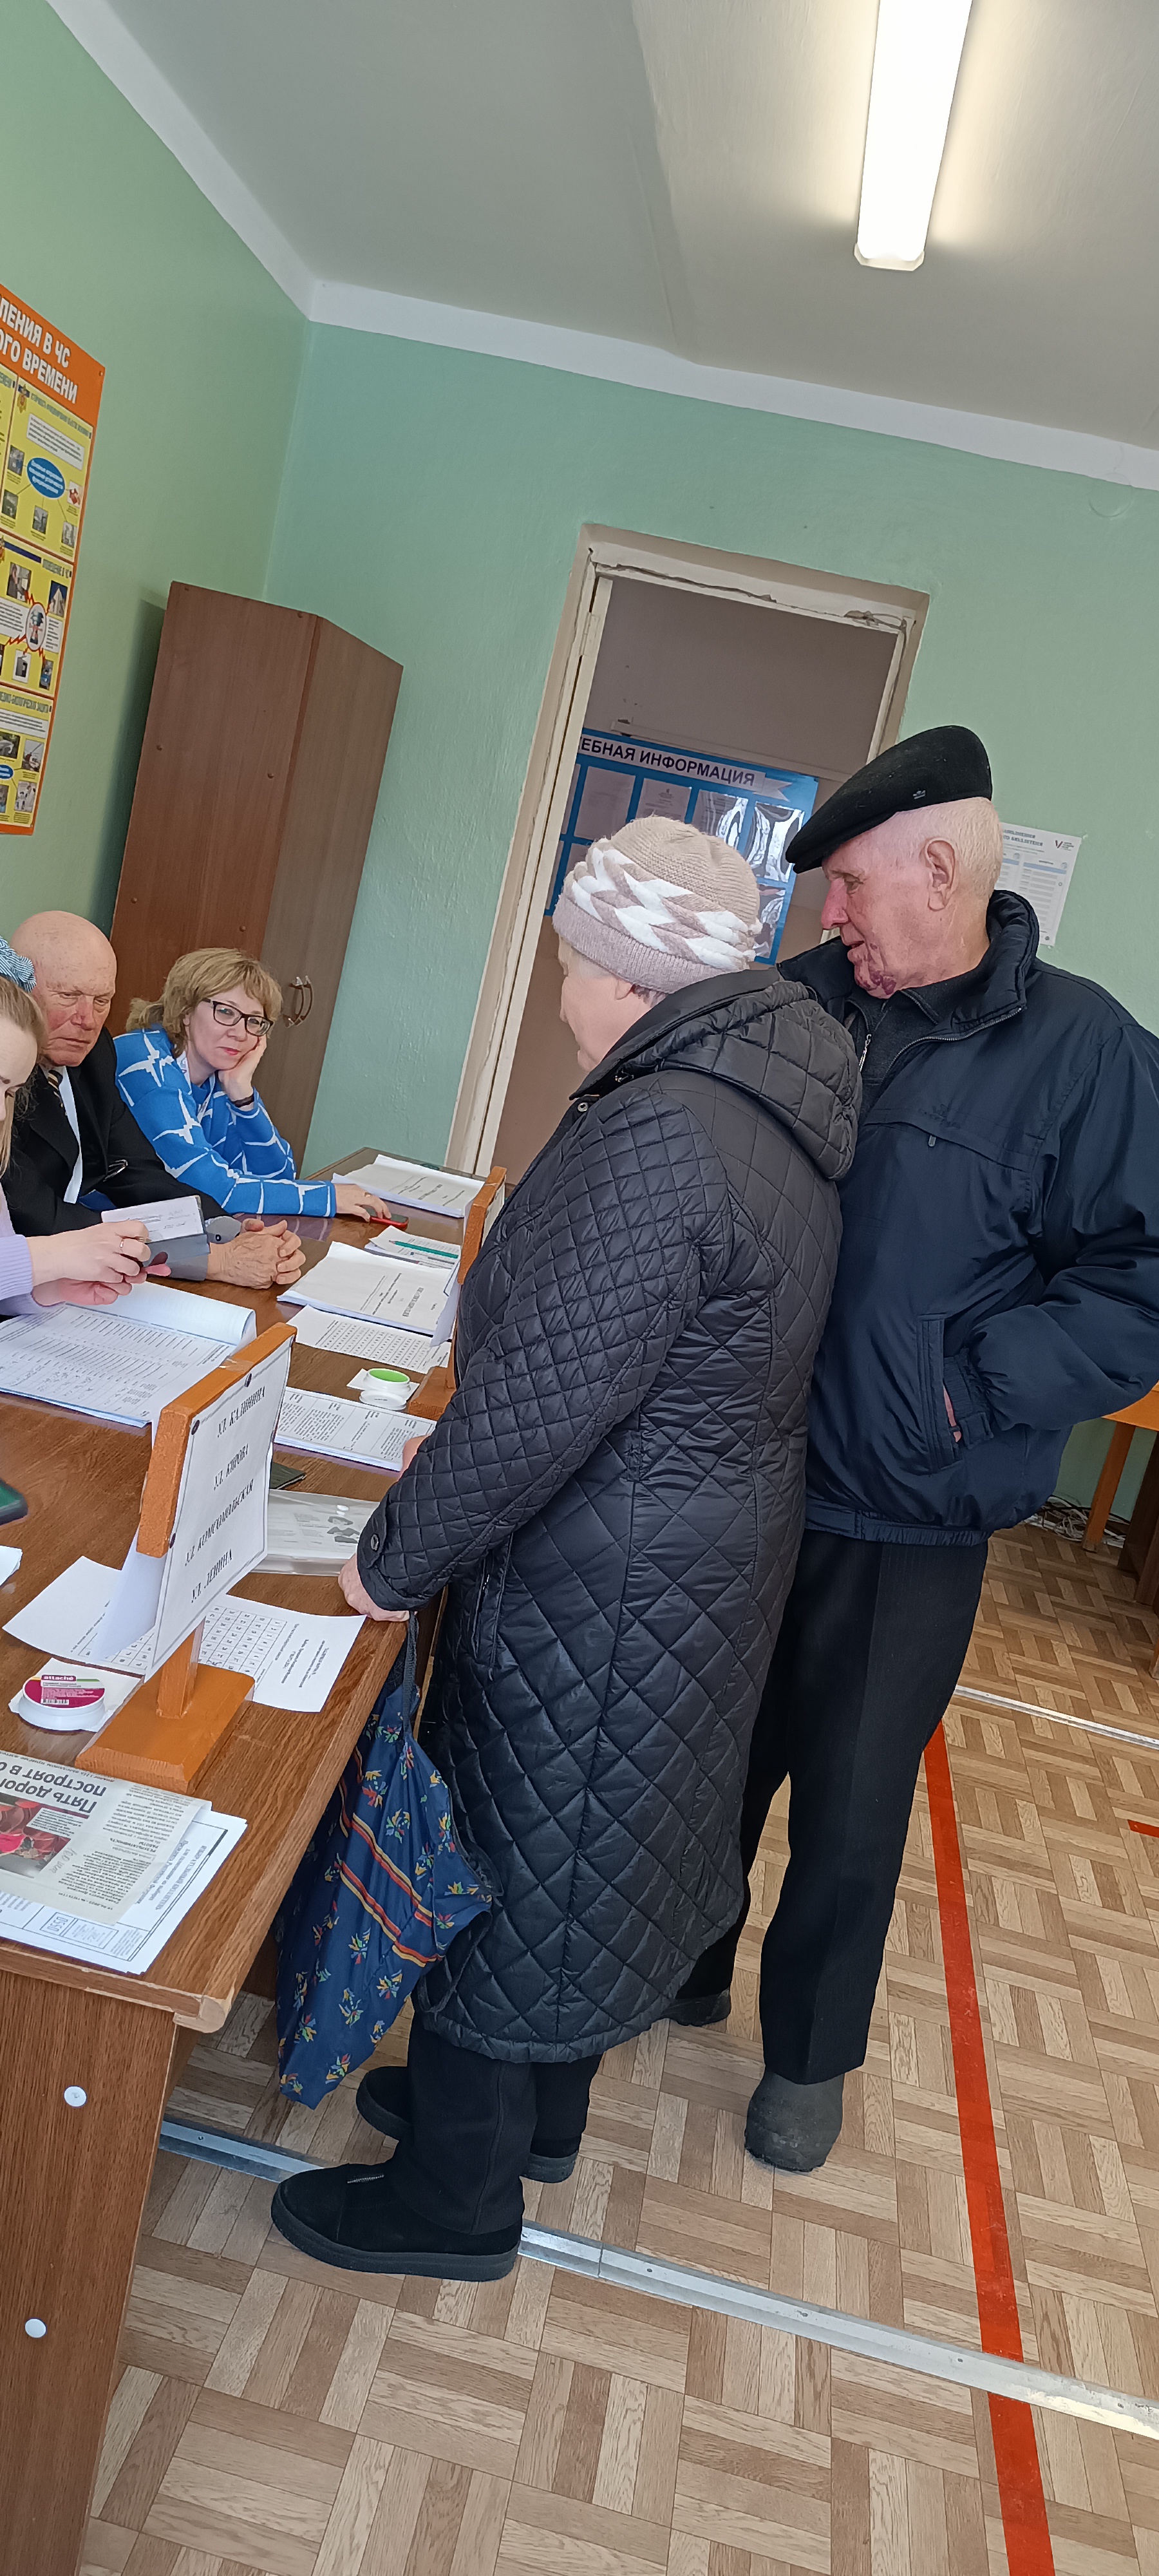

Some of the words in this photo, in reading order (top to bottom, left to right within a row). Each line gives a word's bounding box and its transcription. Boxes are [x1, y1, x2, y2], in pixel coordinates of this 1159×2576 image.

[42, 332, 53, 354] В
[55, 341, 70, 368] ЧС
[23, 348, 78, 404] ВРЕМЕНИ
[580, 737, 636, 761] ЕБНАЯ
[639, 750, 755, 787] ИНФОРМАЦИЯ
[229, 1386, 265, 1427] КАЛИНИНА
[225, 1443, 249, 1477] КИРОВА
[197, 1478, 254, 1551] КОМСОМОЛЬСКАЯ
[203, 1549, 232, 1589] ЛЕНИНА
[9, 1765, 23, 1776] в
[22, 1768, 107, 1797] построят
[53, 1792, 97, 1814] Пять
